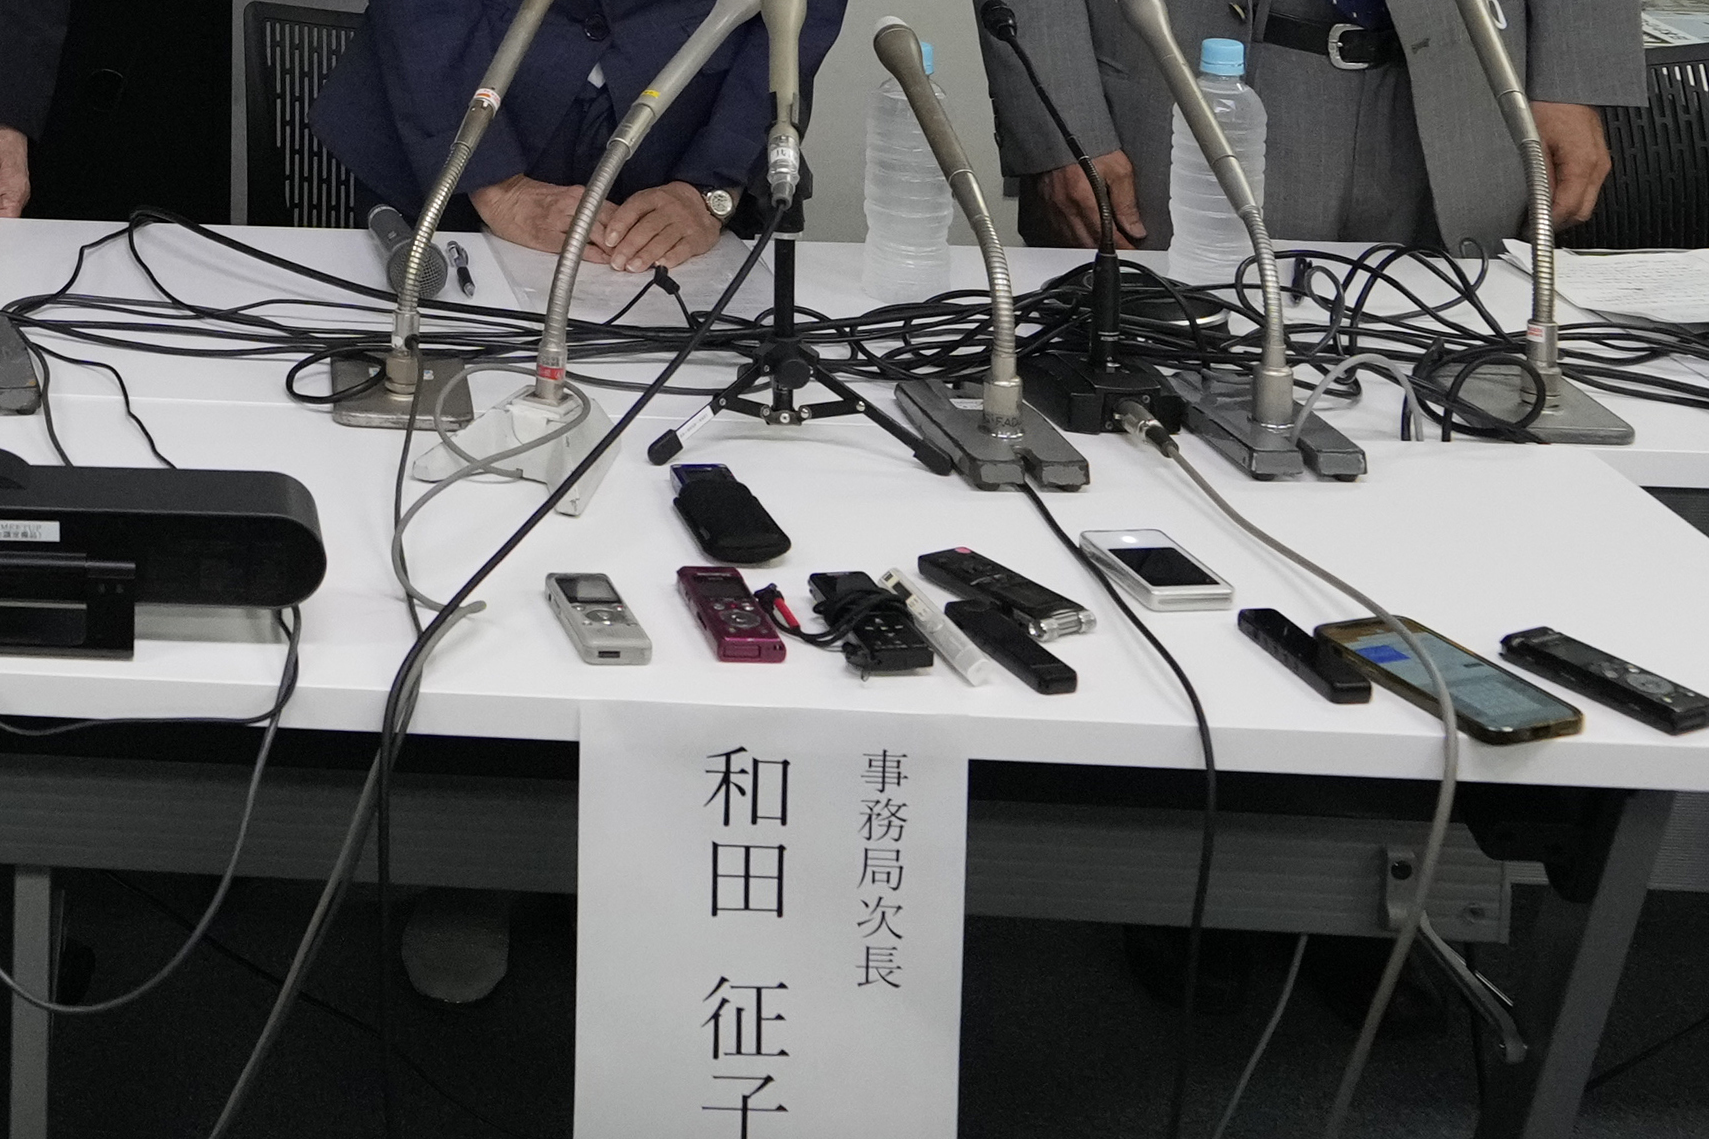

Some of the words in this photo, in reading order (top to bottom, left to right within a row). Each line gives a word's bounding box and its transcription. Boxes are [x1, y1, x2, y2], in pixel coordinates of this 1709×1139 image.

[703, 746, 791, 919] 和田
[855, 749, 909, 989] 事務局次長
[700, 975, 791, 1139] 征子
